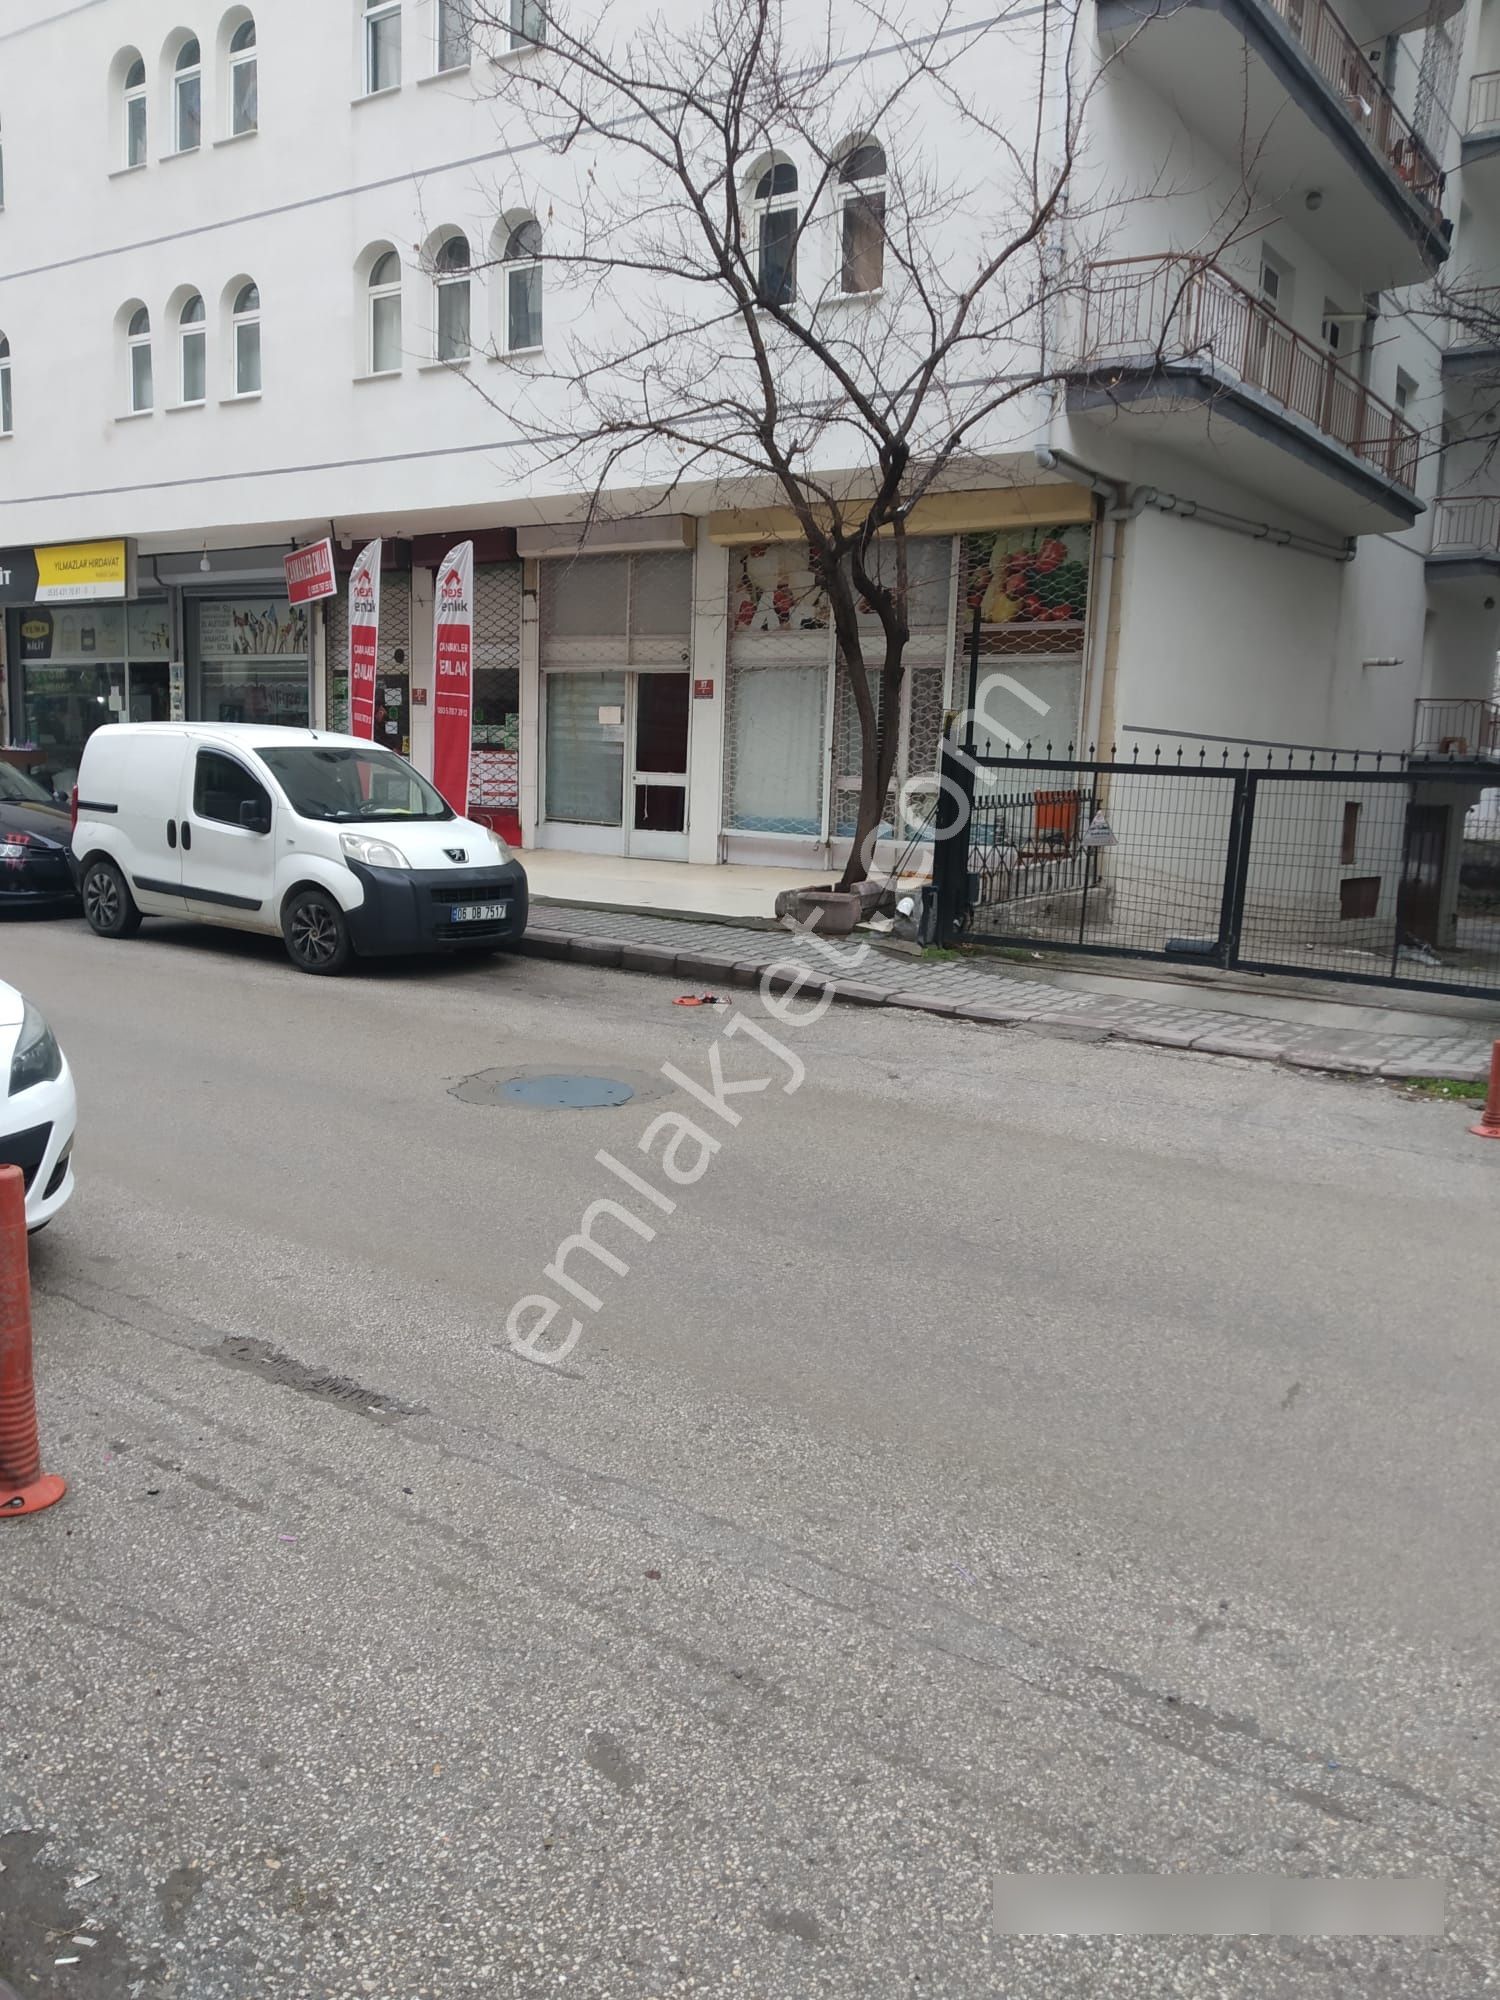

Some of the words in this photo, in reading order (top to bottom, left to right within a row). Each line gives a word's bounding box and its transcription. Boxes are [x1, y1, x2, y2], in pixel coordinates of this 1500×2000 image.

[55, 558, 88, 571] YILMAZLAR
[88, 556, 120, 569] HIRDAVAT
[485, 905, 504, 918] 7517
